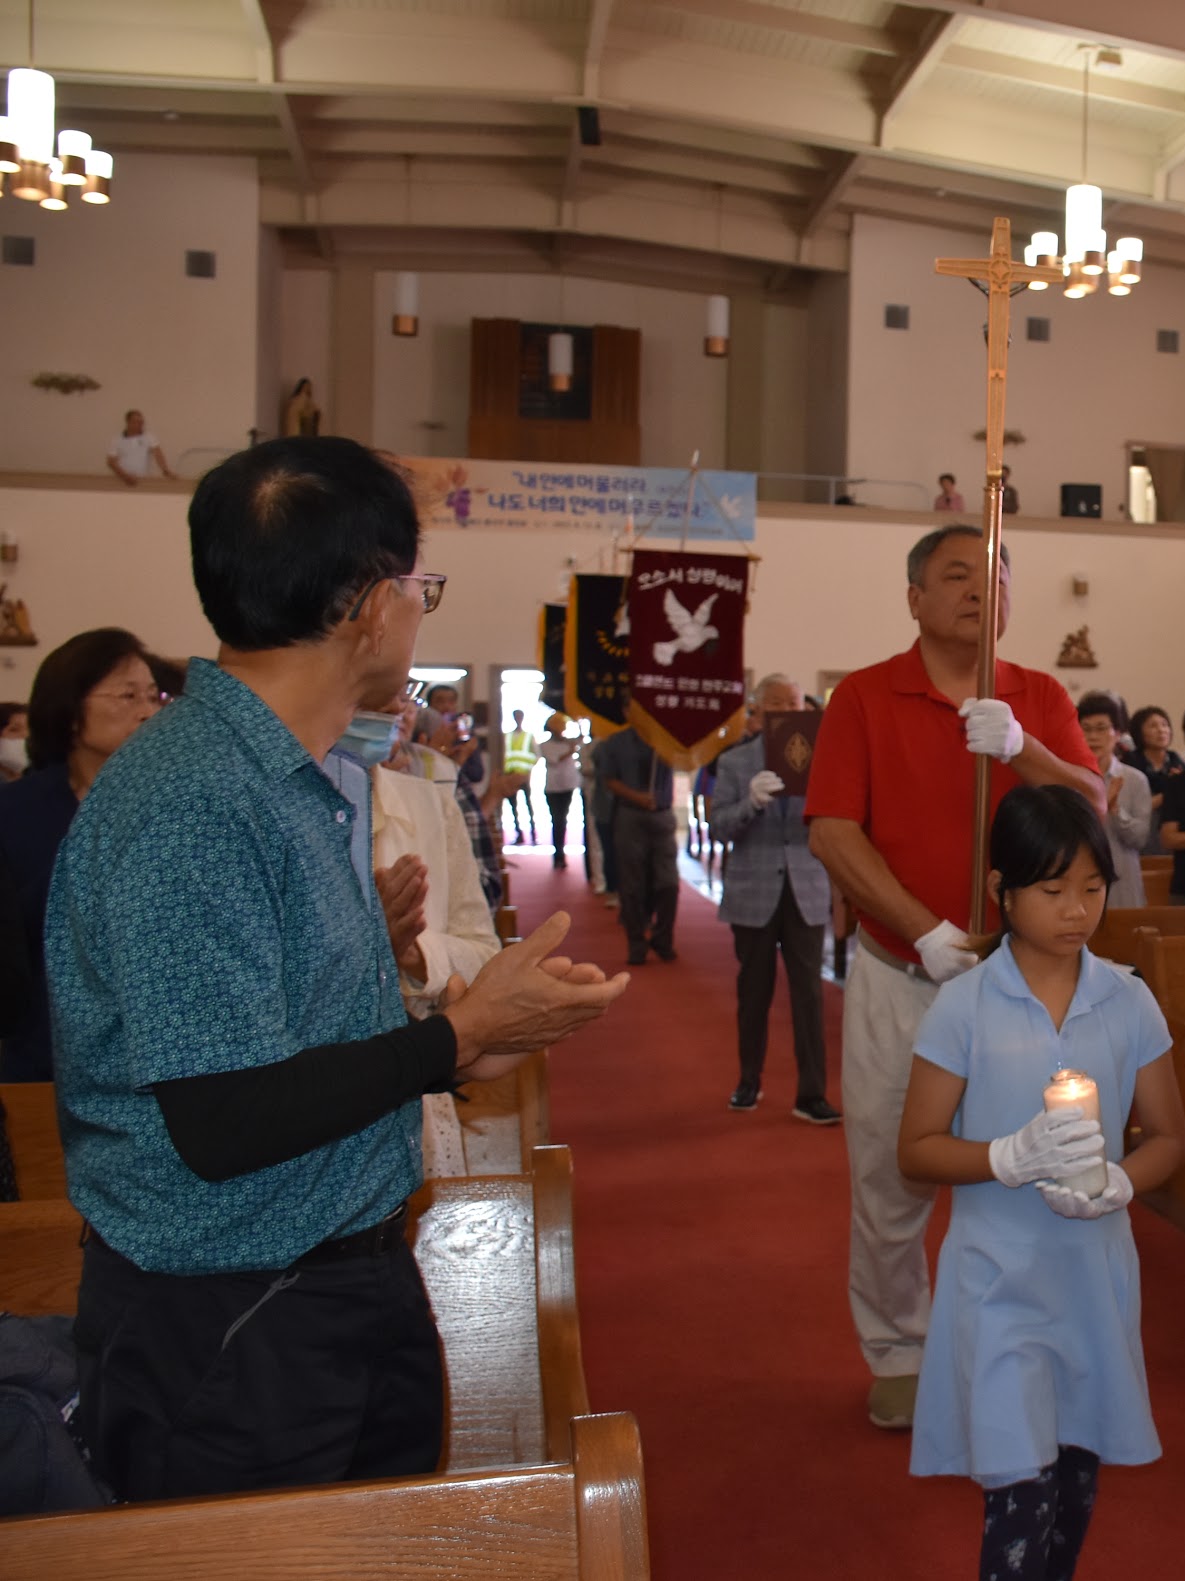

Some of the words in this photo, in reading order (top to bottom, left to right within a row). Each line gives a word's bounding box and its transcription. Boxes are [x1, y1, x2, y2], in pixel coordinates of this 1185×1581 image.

[538, 473, 574, 491] 안에
[488, 493, 526, 511] 나도
[527, 496, 566, 512] 너희
[569, 495, 606, 515] 안에
[638, 567, 684, 591] 오소서
